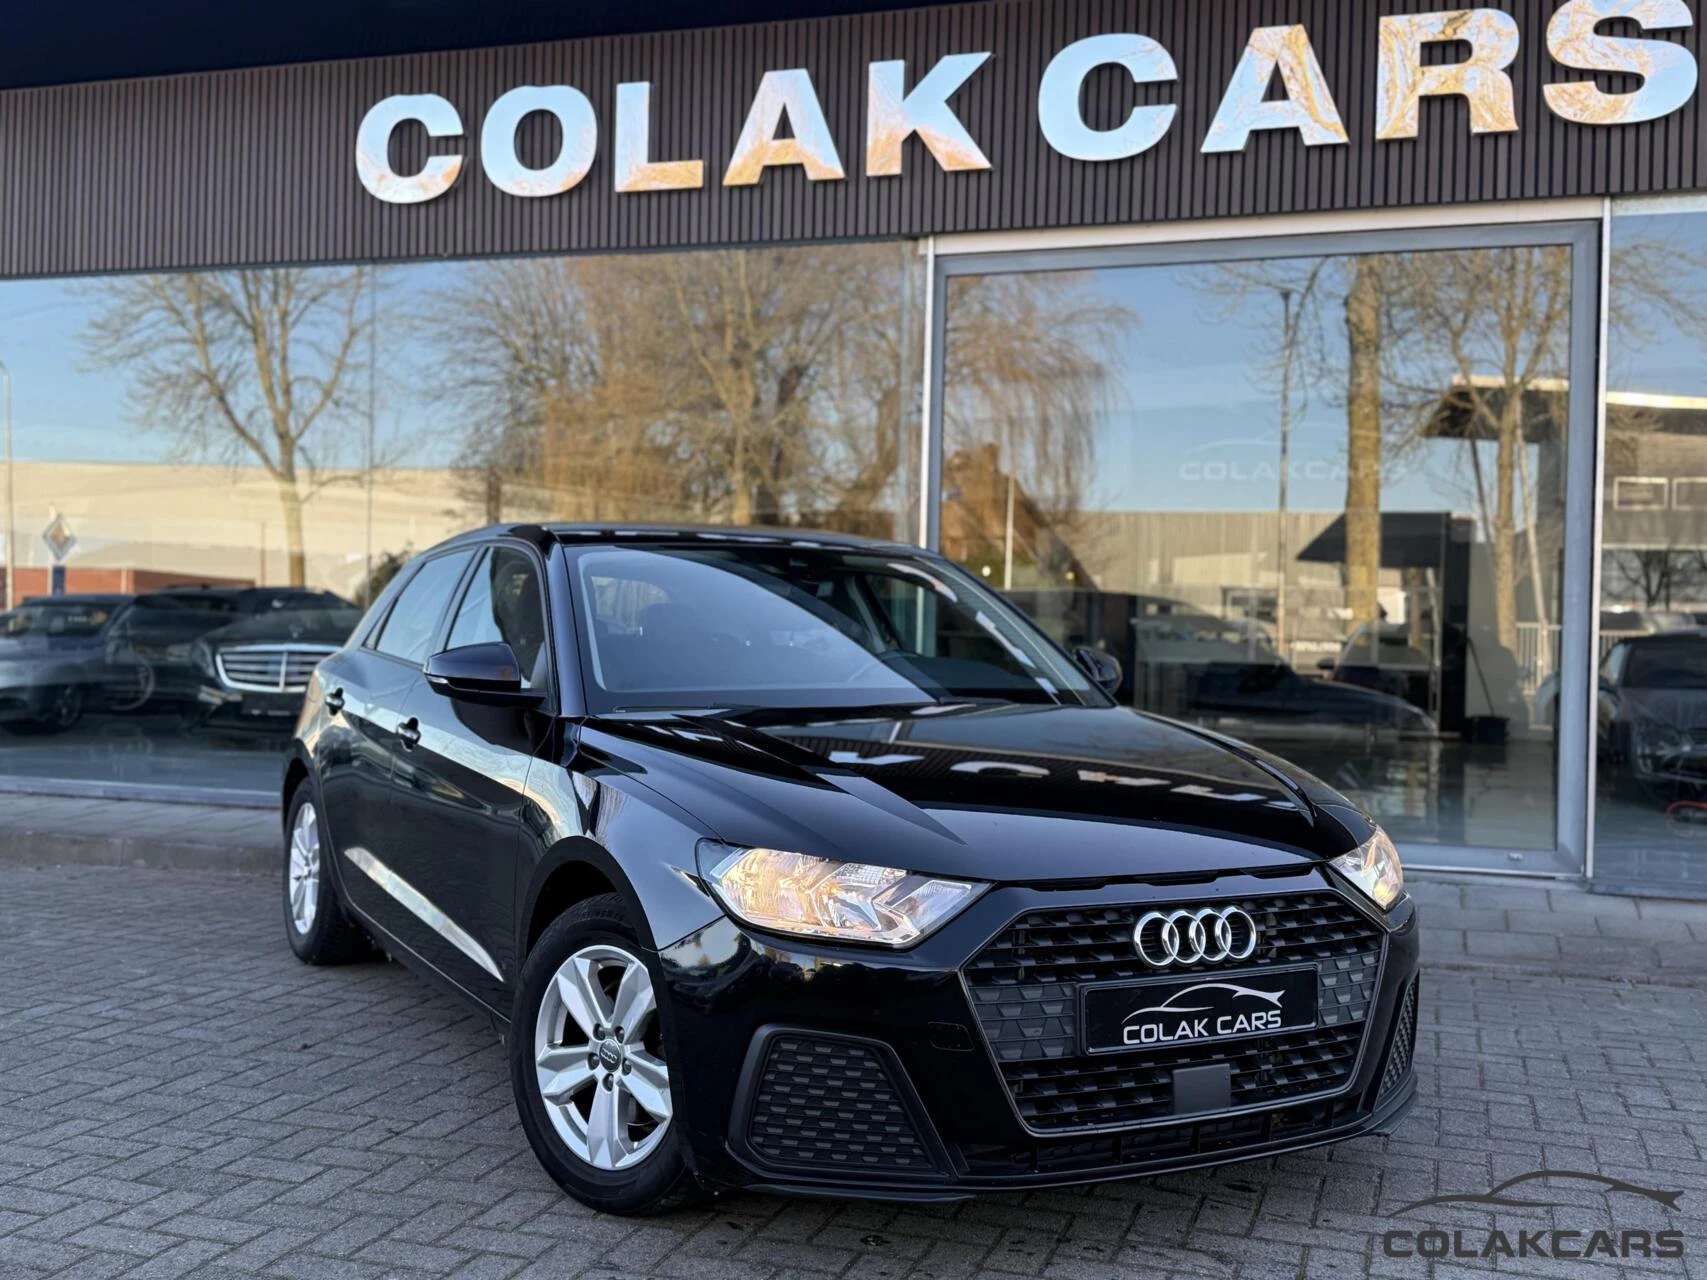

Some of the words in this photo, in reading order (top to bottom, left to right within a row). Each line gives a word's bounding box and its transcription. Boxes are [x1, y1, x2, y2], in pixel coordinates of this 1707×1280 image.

[355, 51, 993, 204] COLAK
[1038, 0, 1698, 161] CARS
[1123, 1018, 1209, 1045] COLAK
[1216, 1010, 1282, 1035] CARS
